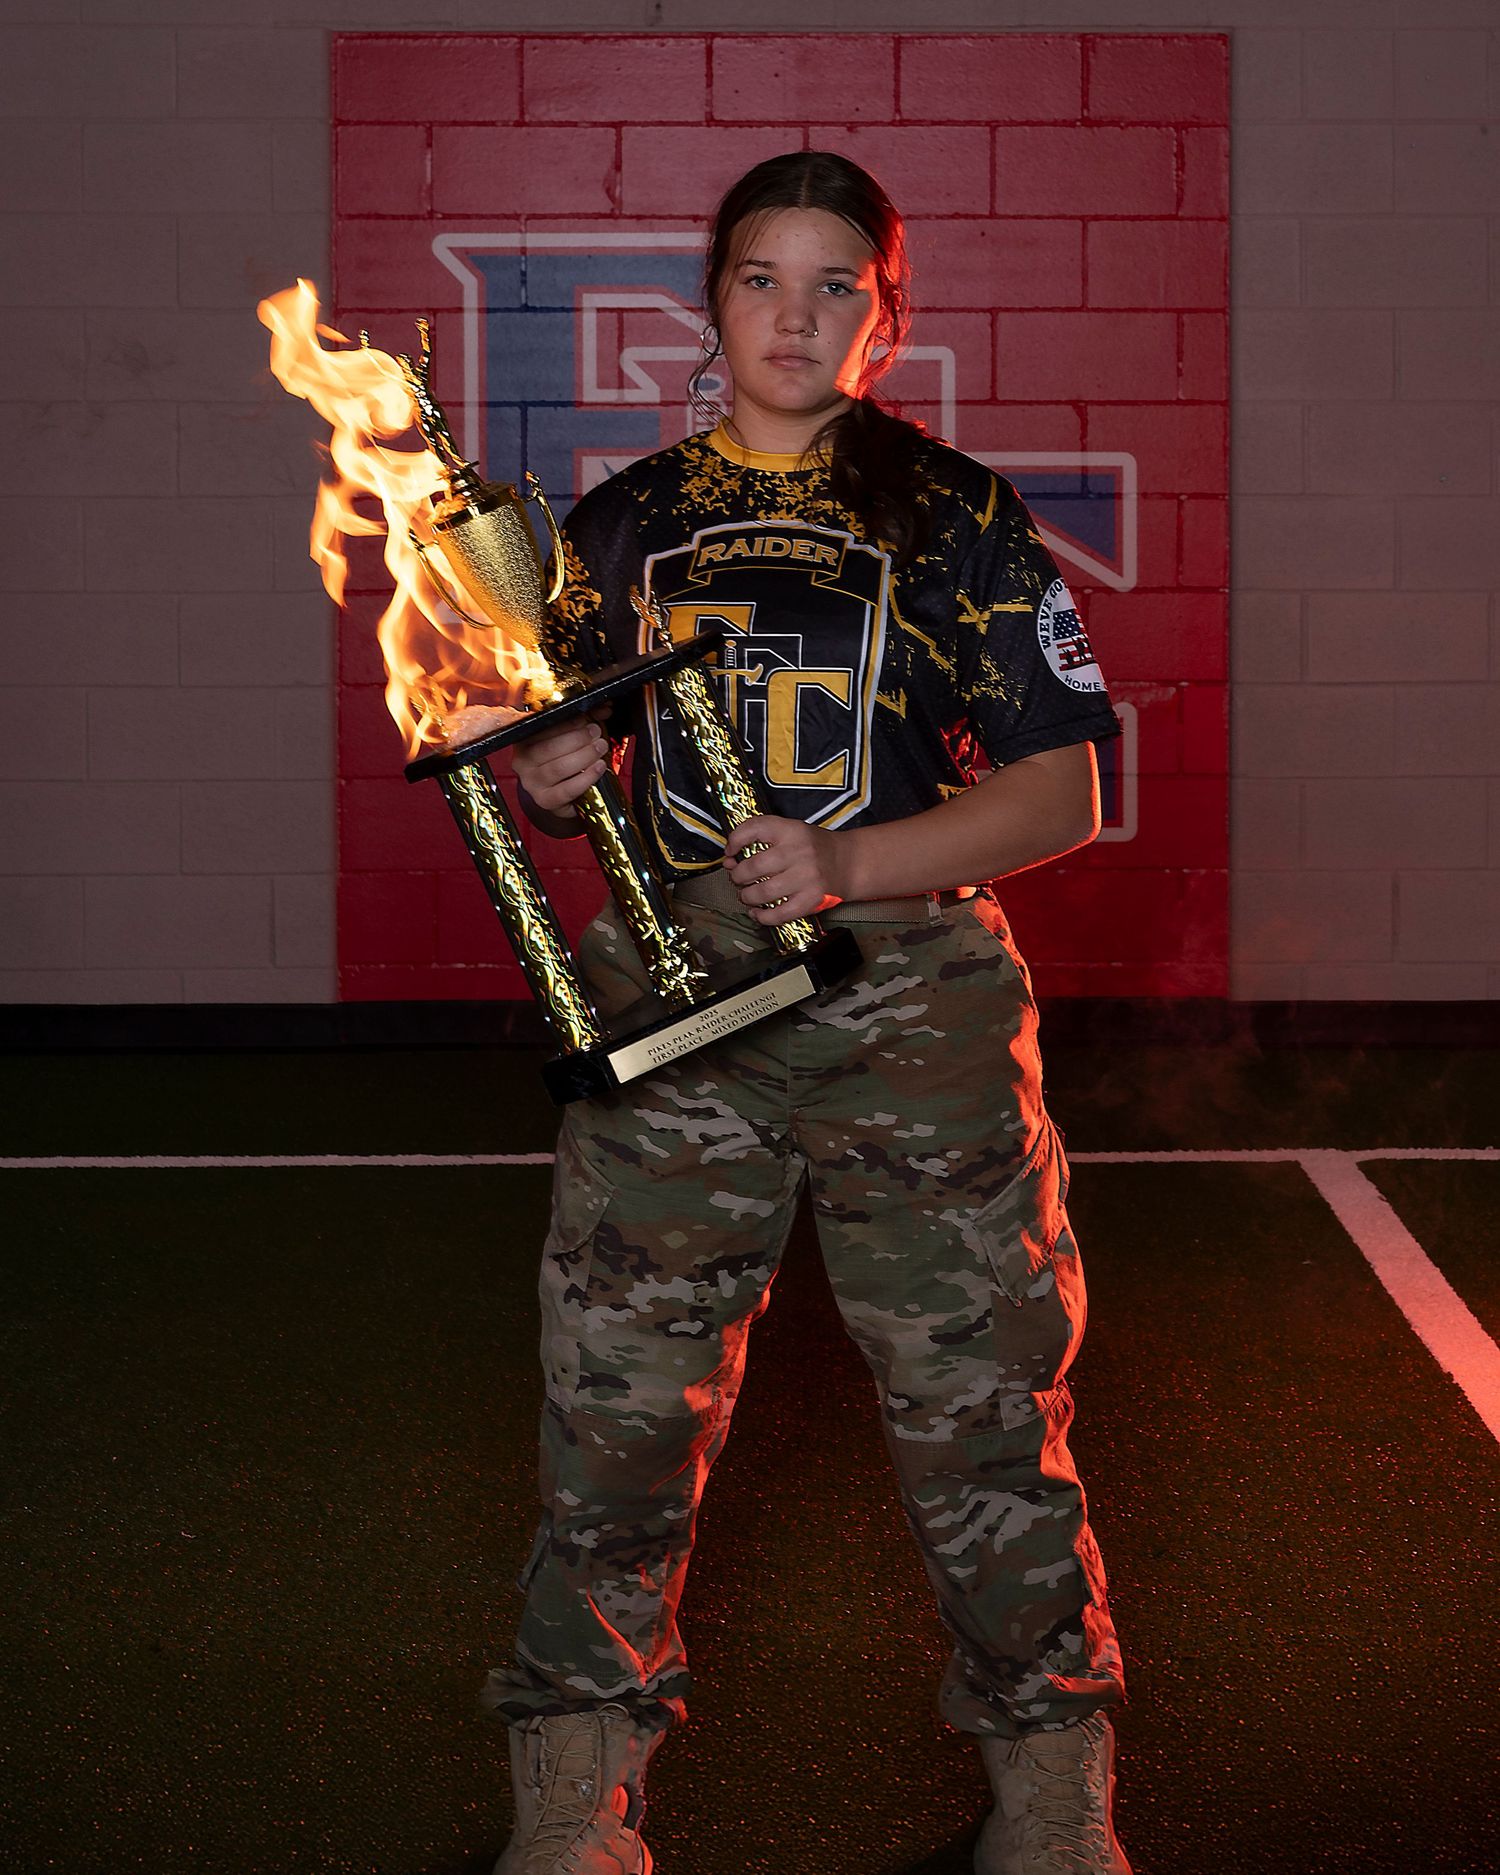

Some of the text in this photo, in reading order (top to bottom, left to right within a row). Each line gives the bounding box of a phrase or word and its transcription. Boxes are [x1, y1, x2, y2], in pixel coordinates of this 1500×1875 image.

[697, 536, 839, 567] RAIDER
[1064, 674, 1101, 692] HOME
[647, 991, 777, 1056] PIKES PEAK RAIDER CHALLENGE
[699, 1009, 719, 1022] 2025
[652, 1048, 676, 1064] FIRST
[678, 1036, 704, 1052] PLACE
[711, 1019, 739, 1037] MIXED
[739, 1000, 780, 1023] DIVISION
